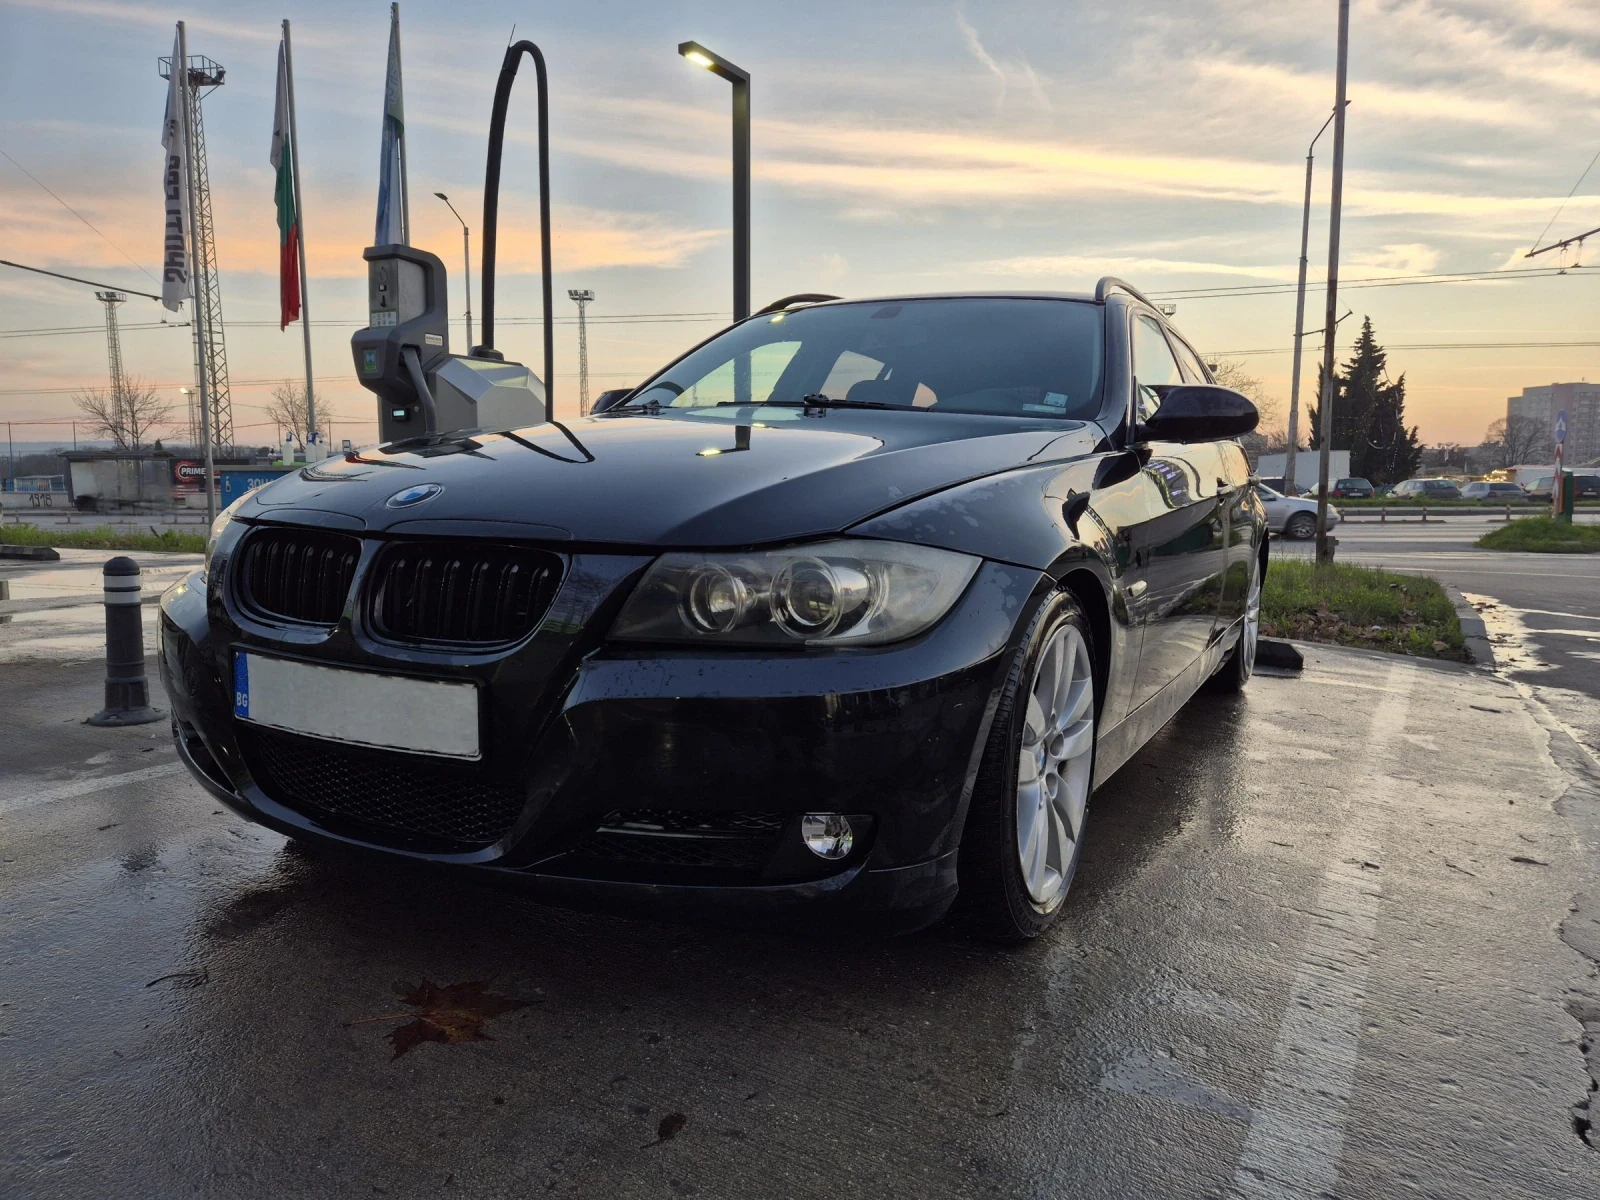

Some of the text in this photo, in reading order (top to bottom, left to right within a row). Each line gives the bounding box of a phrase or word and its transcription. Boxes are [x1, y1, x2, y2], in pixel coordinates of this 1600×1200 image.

[181, 467, 206, 475] PRIME
[246, 477, 275, 490] ЗО
[236, 691, 248, 708] BG
